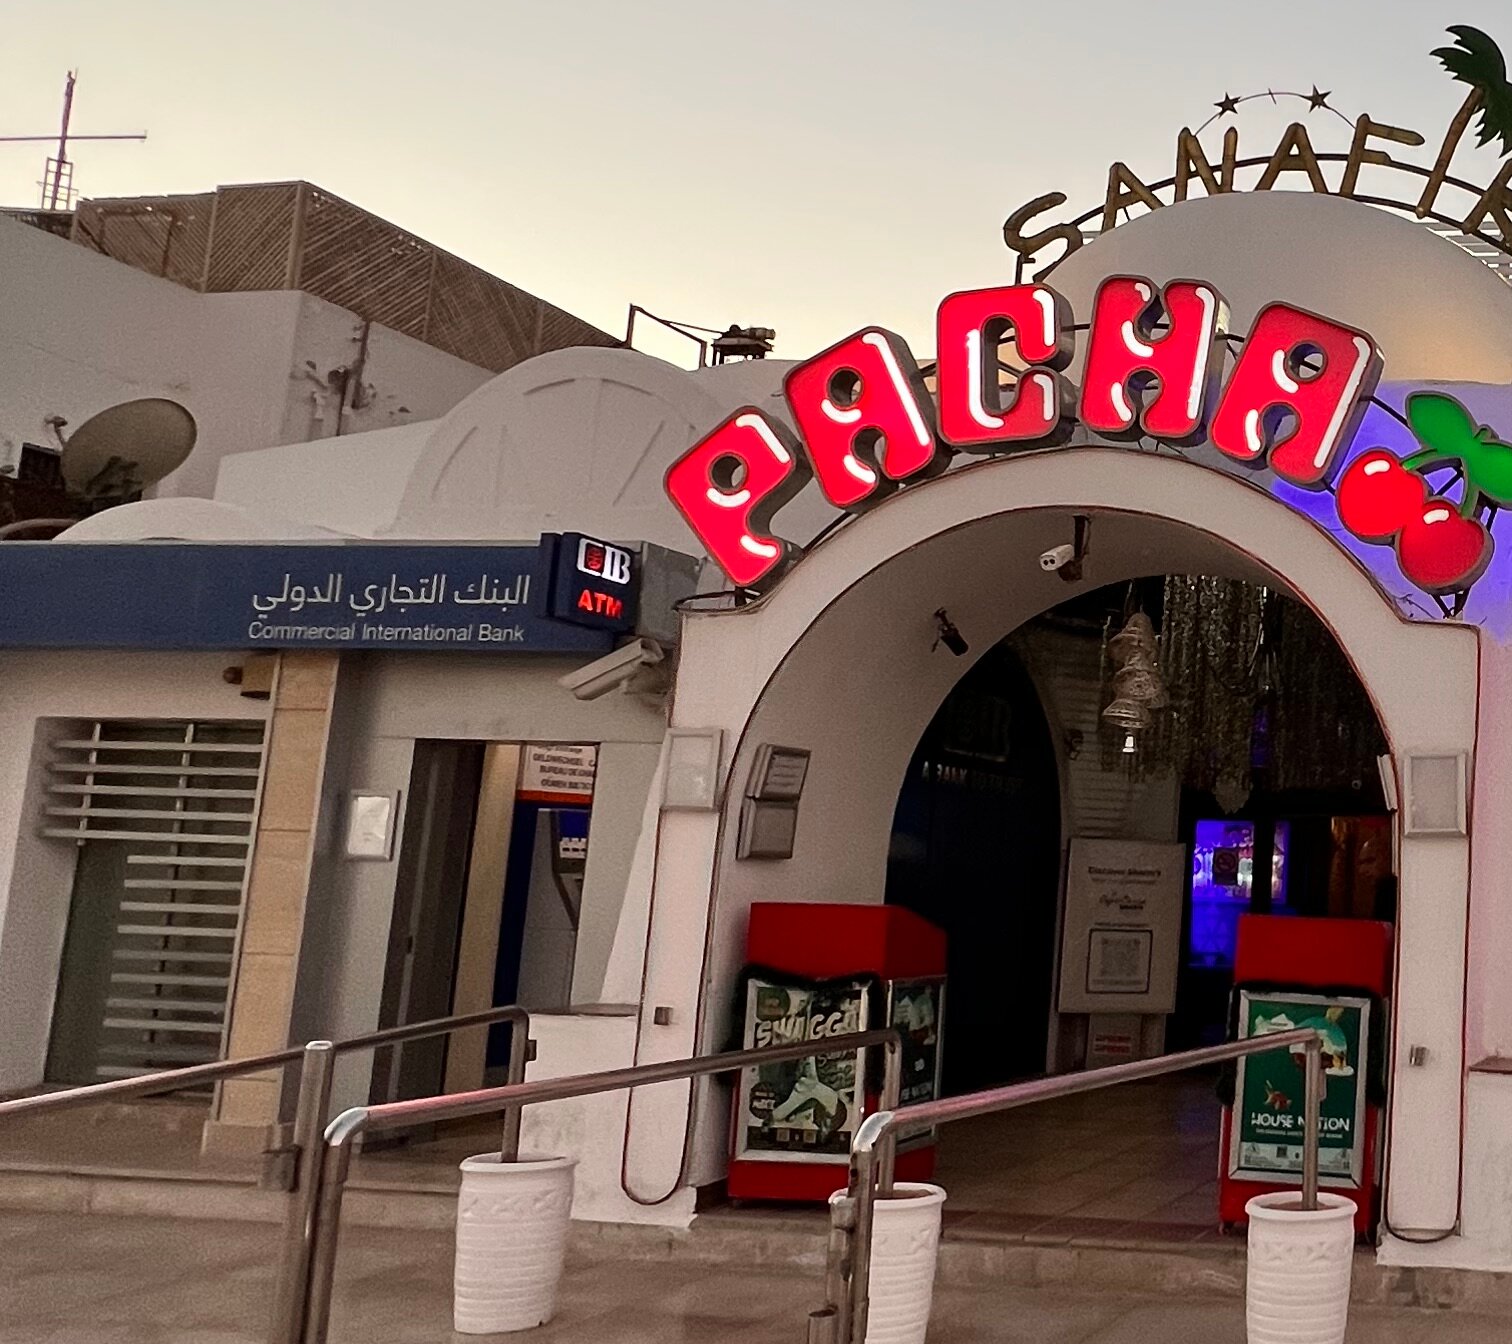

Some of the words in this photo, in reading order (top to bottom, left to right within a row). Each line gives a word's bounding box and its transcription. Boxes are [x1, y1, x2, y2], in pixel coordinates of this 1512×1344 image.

[664, 274, 1384, 587] PACHA
[252, 573, 343, 620] الدولي
[349, 573, 447, 618] التجاري
[453, 573, 531, 613] البنك
[577, 588, 624, 620] ATM
[248, 621, 356, 641] Commercial
[362, 623, 473, 642] International
[478, 623, 525, 642] Bank
[1297, 1116, 1350, 1132] NTION
